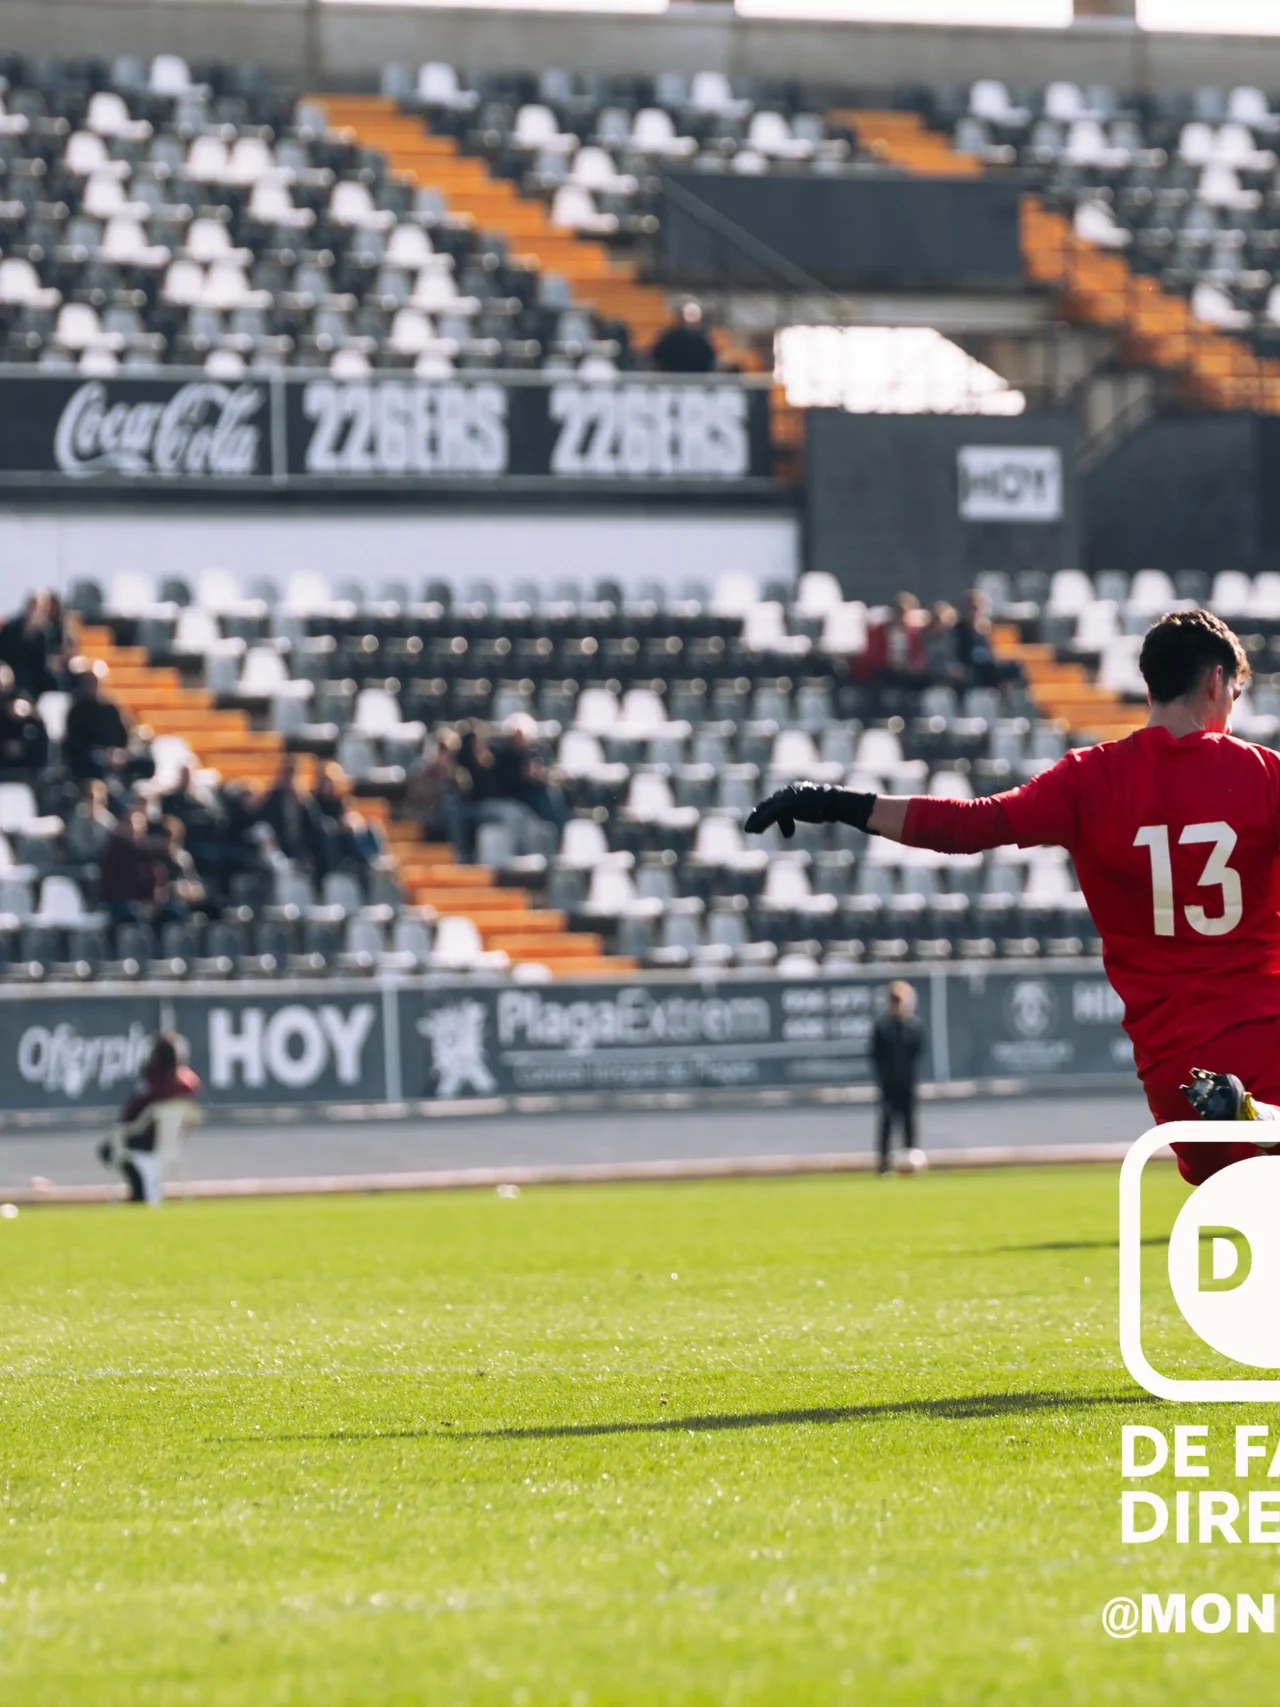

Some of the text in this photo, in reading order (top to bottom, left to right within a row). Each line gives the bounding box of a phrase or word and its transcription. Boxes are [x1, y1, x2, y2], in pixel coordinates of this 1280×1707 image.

[304, 383, 506, 474] 226ERS
[550, 386, 748, 475] 226ERS
[1133, 821, 1242, 937] 13
[208, 1004, 374, 1088] HOY
